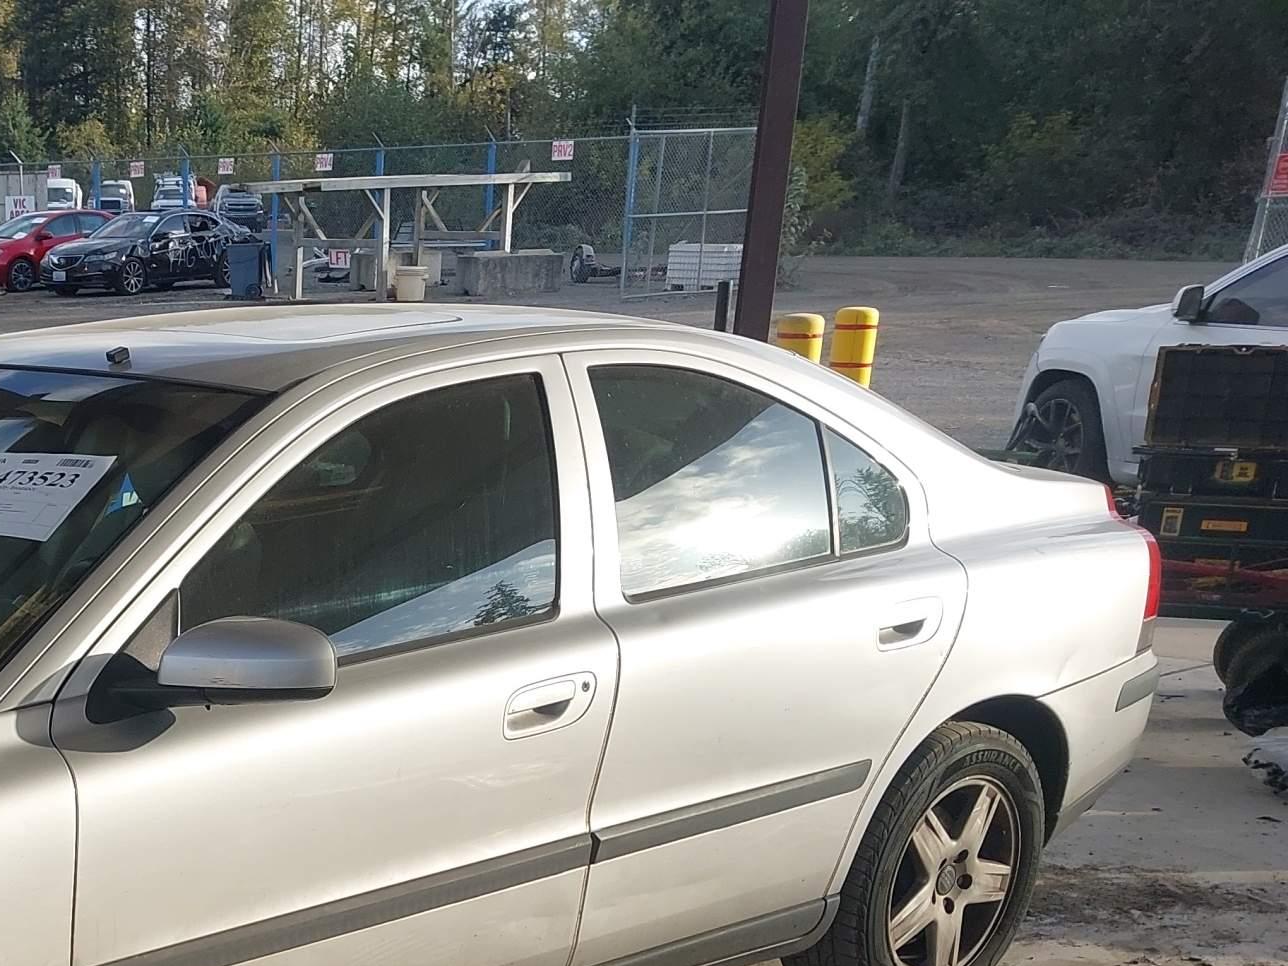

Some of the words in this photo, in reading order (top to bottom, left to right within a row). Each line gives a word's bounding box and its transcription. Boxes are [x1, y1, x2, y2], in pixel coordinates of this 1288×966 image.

[552, 143, 573, 157] PRV2
[13, 198, 26, 209] VIC
[330, 250, 348, 265] LFT
[963, 751, 1022, 773] ASSURANCE
